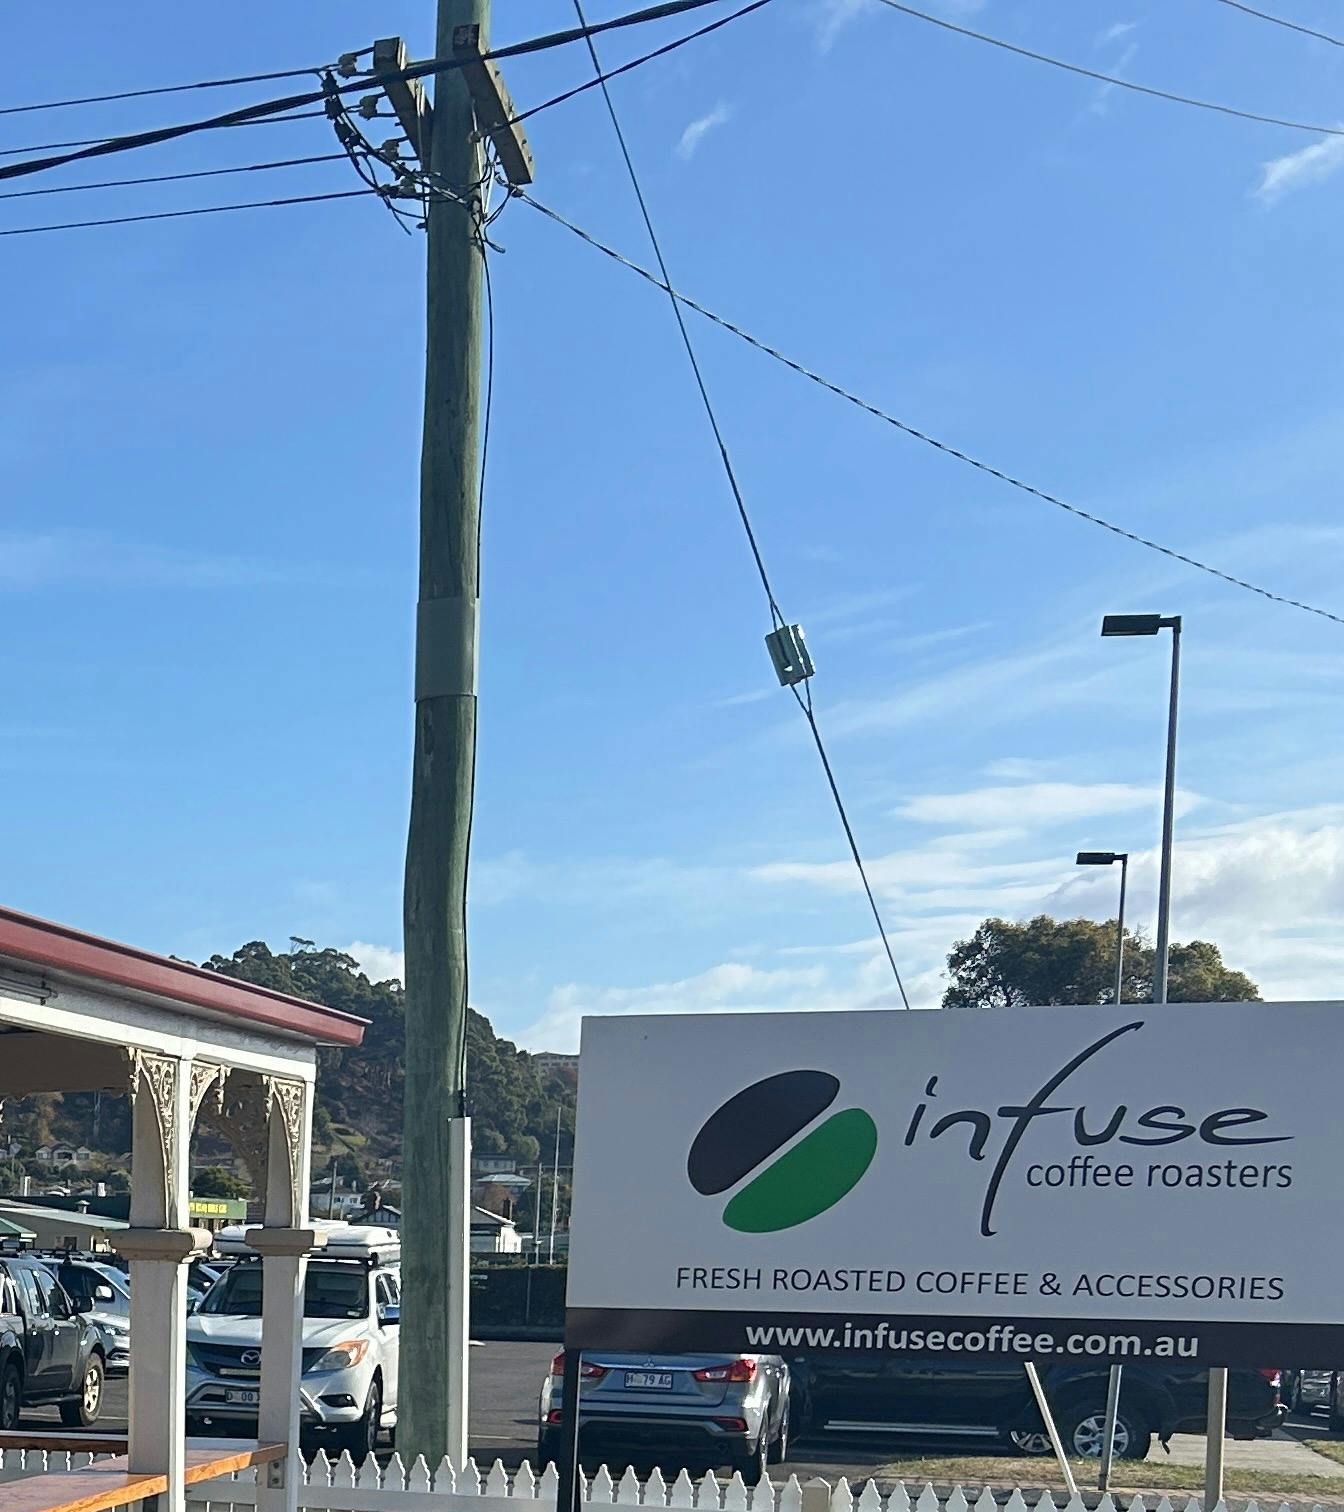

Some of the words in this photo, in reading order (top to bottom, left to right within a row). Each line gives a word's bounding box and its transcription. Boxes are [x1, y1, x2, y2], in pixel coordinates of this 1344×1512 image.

[905, 1021, 1295, 1236] infuse
[1025, 1156, 1134, 1189] coffee
[1147, 1158, 1293, 1190] roasters
[677, 1266, 762, 1291] FRESH
[773, 1268, 906, 1294] ROASTED
[916, 1270, 1029, 1297] COFFEE
[1039, 1273, 1063, 1297] &
[1072, 1273, 1285, 1301] ACCESSORIES
[745, 1322, 1200, 1358] www.infusecoffee.com.au
